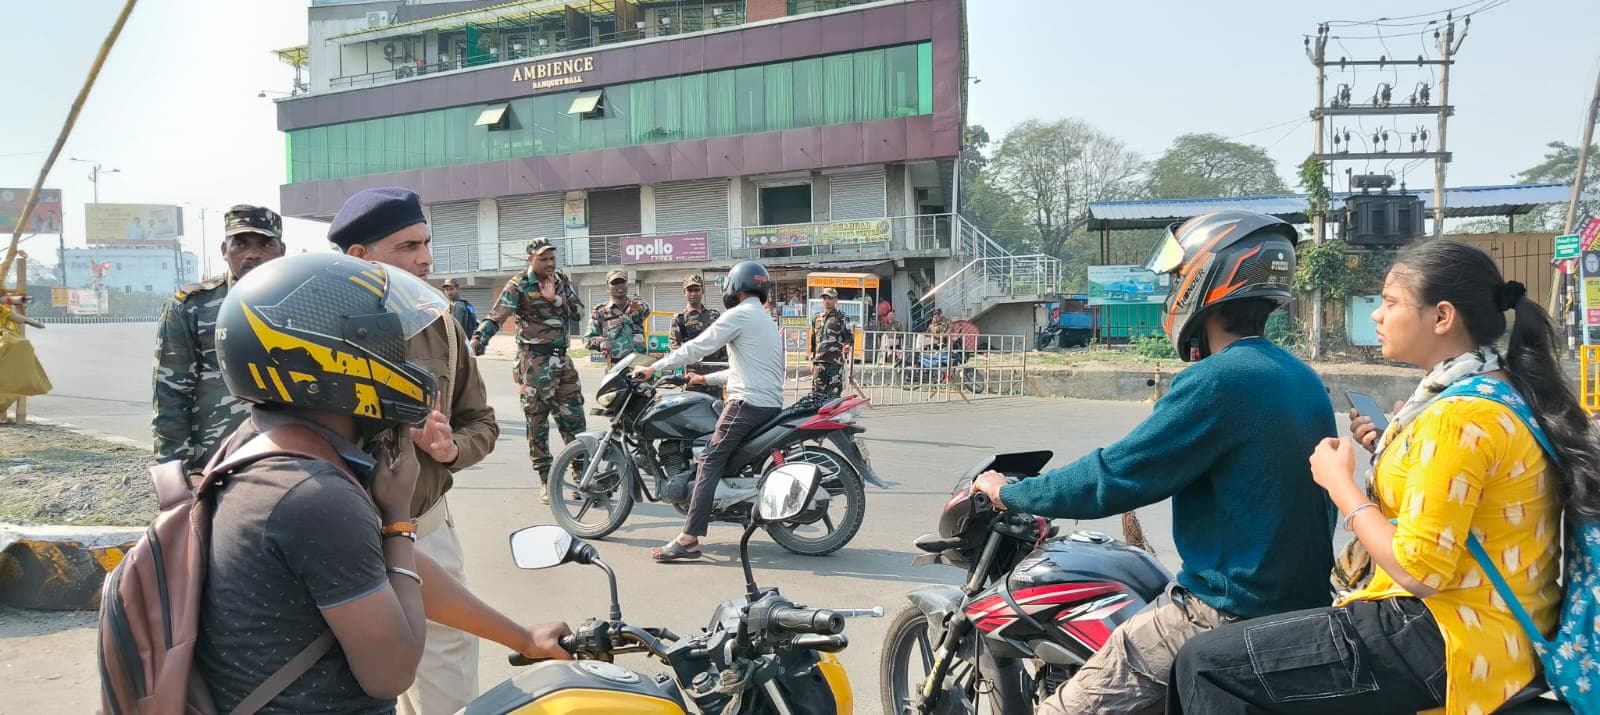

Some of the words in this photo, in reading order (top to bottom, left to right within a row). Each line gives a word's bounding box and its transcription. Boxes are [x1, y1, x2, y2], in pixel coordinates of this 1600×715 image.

[512, 56, 594, 81] AMBIENCE
[533, 78, 564, 89] BANQUET
[564, 75, 583, 84] HALL
[625, 239, 674, 261] apollo
